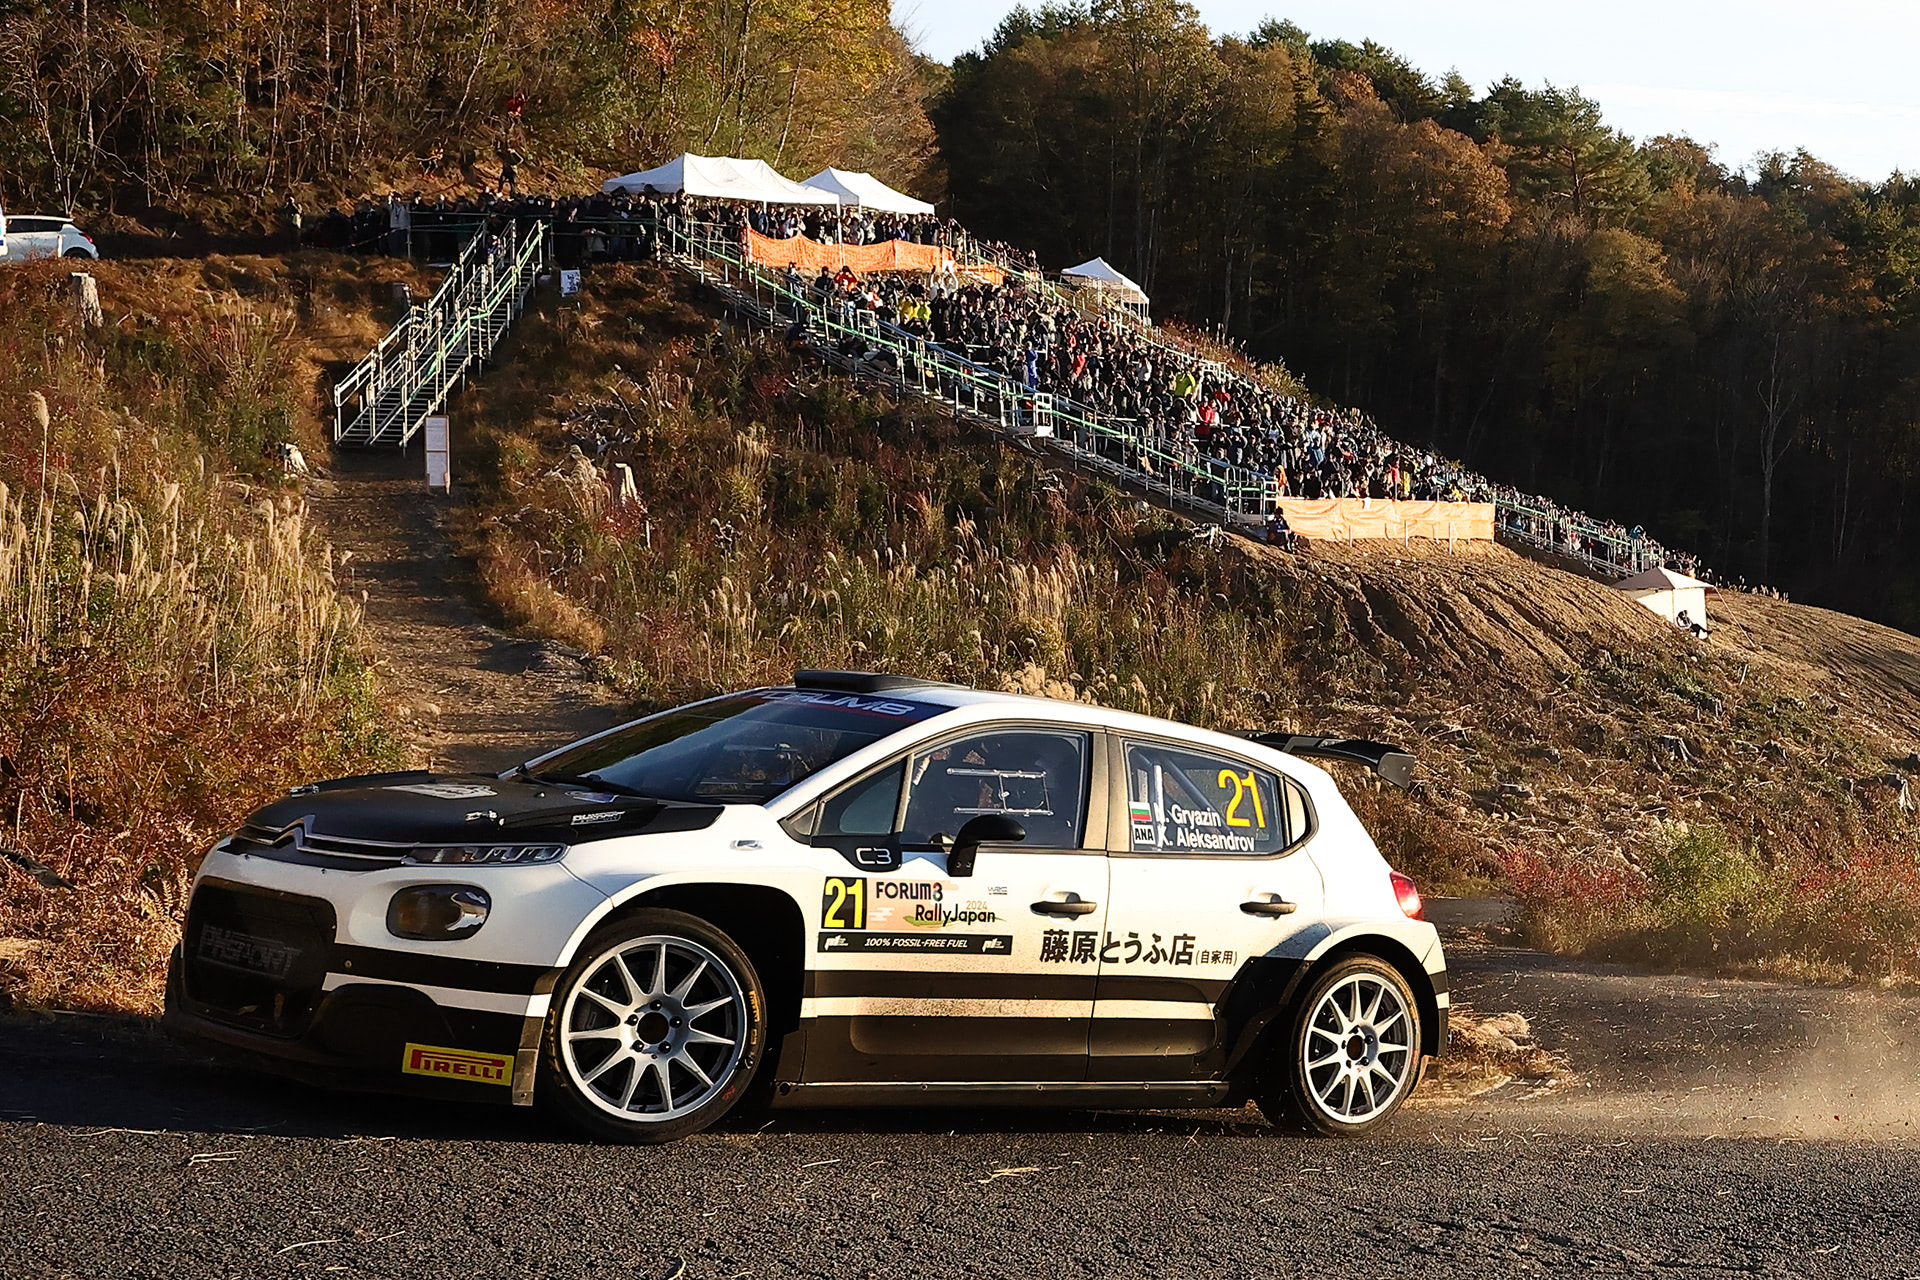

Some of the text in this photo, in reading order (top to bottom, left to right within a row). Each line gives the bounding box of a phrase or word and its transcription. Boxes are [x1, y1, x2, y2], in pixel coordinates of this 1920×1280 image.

[1217, 769, 1265, 828] 21
[1171, 803, 1222, 829] Gryazin
[1134, 827, 1154, 841] ANA
[1176, 827, 1255, 851] Aleksandrov
[855, 847, 892, 865] C3
[824, 878, 863, 929] 21
[966, 901, 988, 910] 2024
[864, 938, 968, 948] 100% FOSSIL-FREE FUEL
[410, 1048, 505, 1080] PIRELLI
